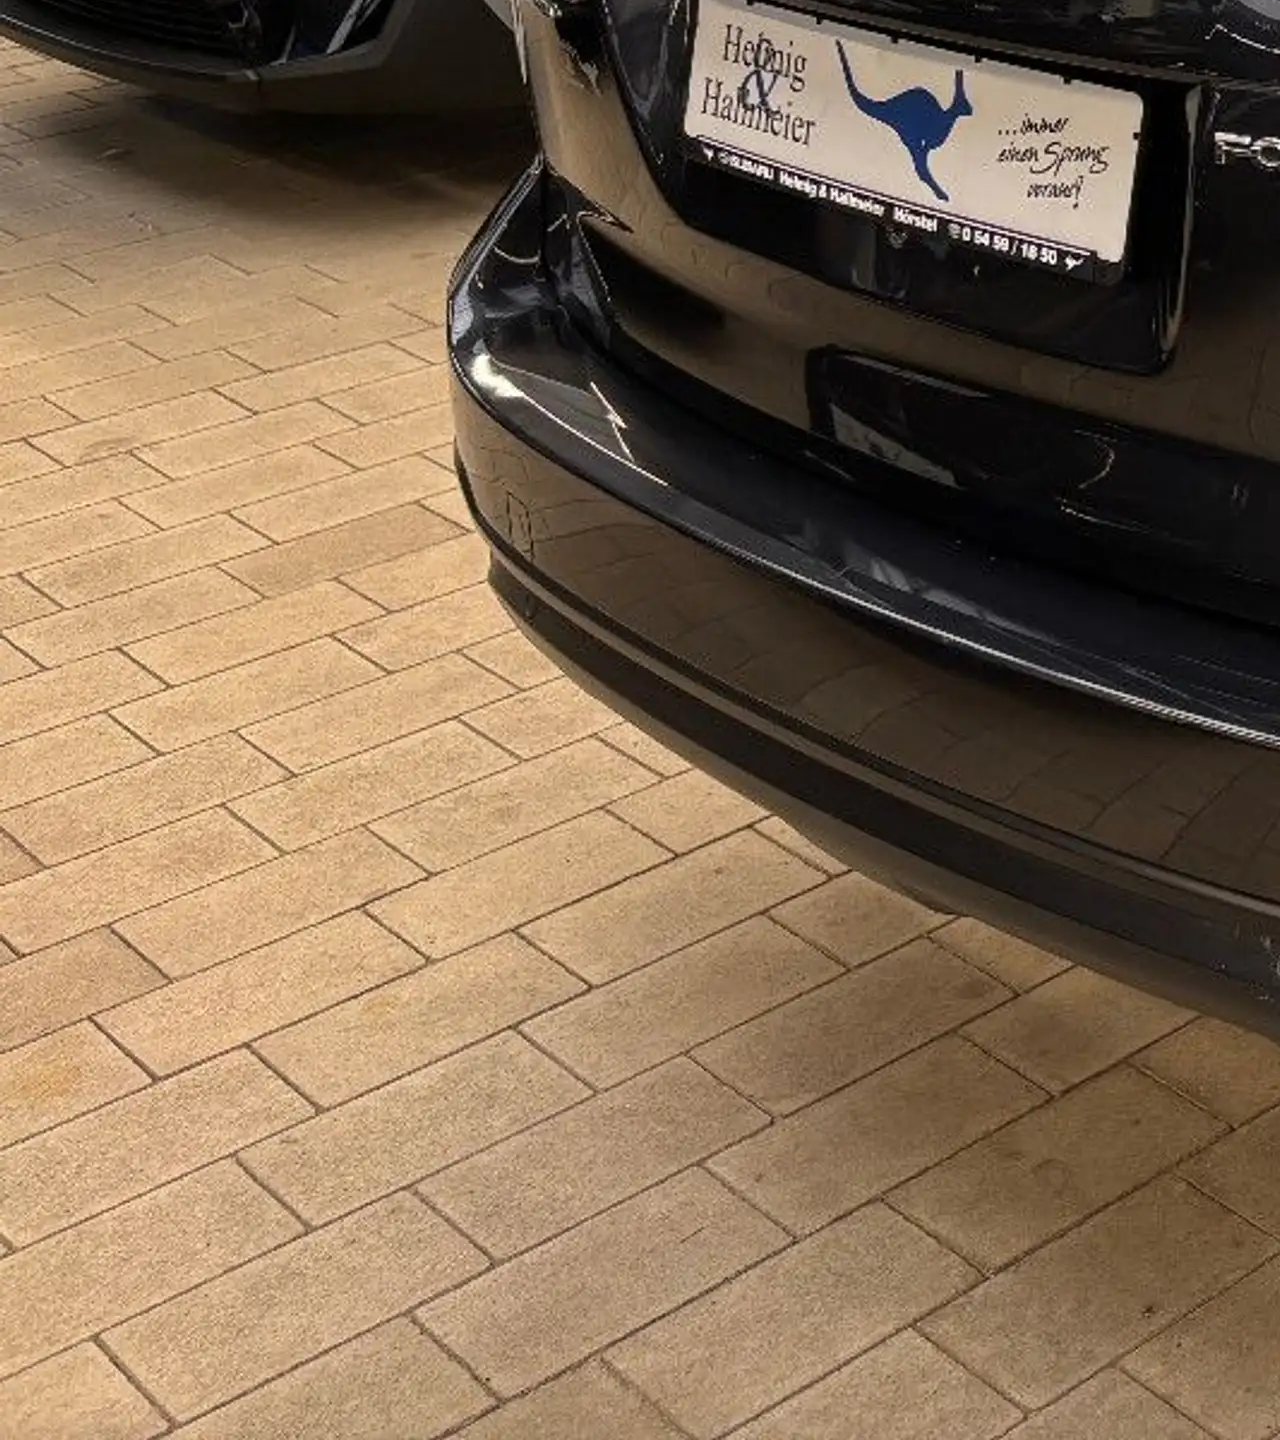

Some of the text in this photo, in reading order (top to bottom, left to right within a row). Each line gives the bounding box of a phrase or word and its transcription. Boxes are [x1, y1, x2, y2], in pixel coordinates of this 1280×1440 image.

[997, 141, 1110, 176] einen Sprung
[1039, 248, 1058, 266] 50
